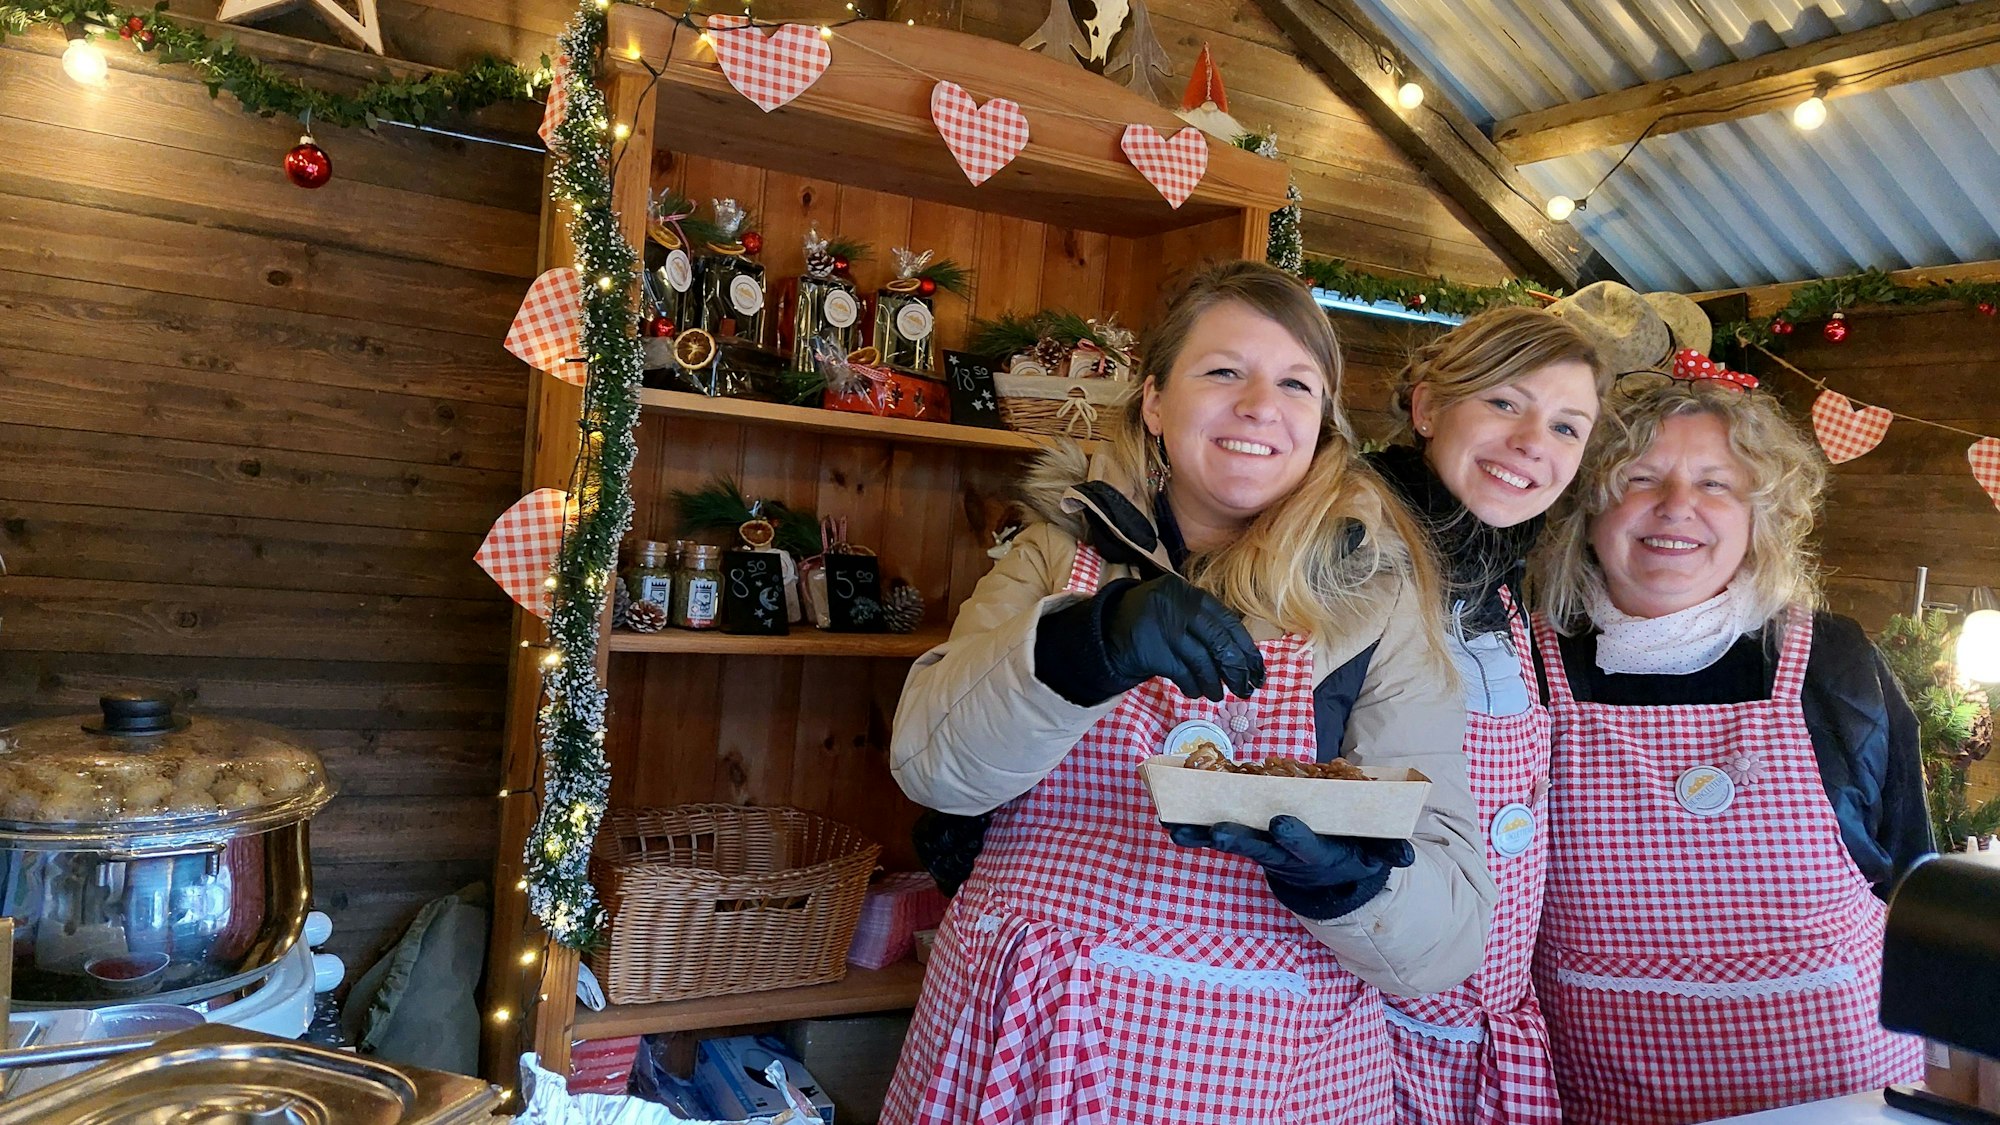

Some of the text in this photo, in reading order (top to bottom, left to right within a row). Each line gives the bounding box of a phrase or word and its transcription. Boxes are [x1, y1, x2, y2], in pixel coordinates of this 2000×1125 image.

[952, 366, 975, 391] 18
[730, 568, 749, 598] 8
[836, 570, 854, 599] 5
